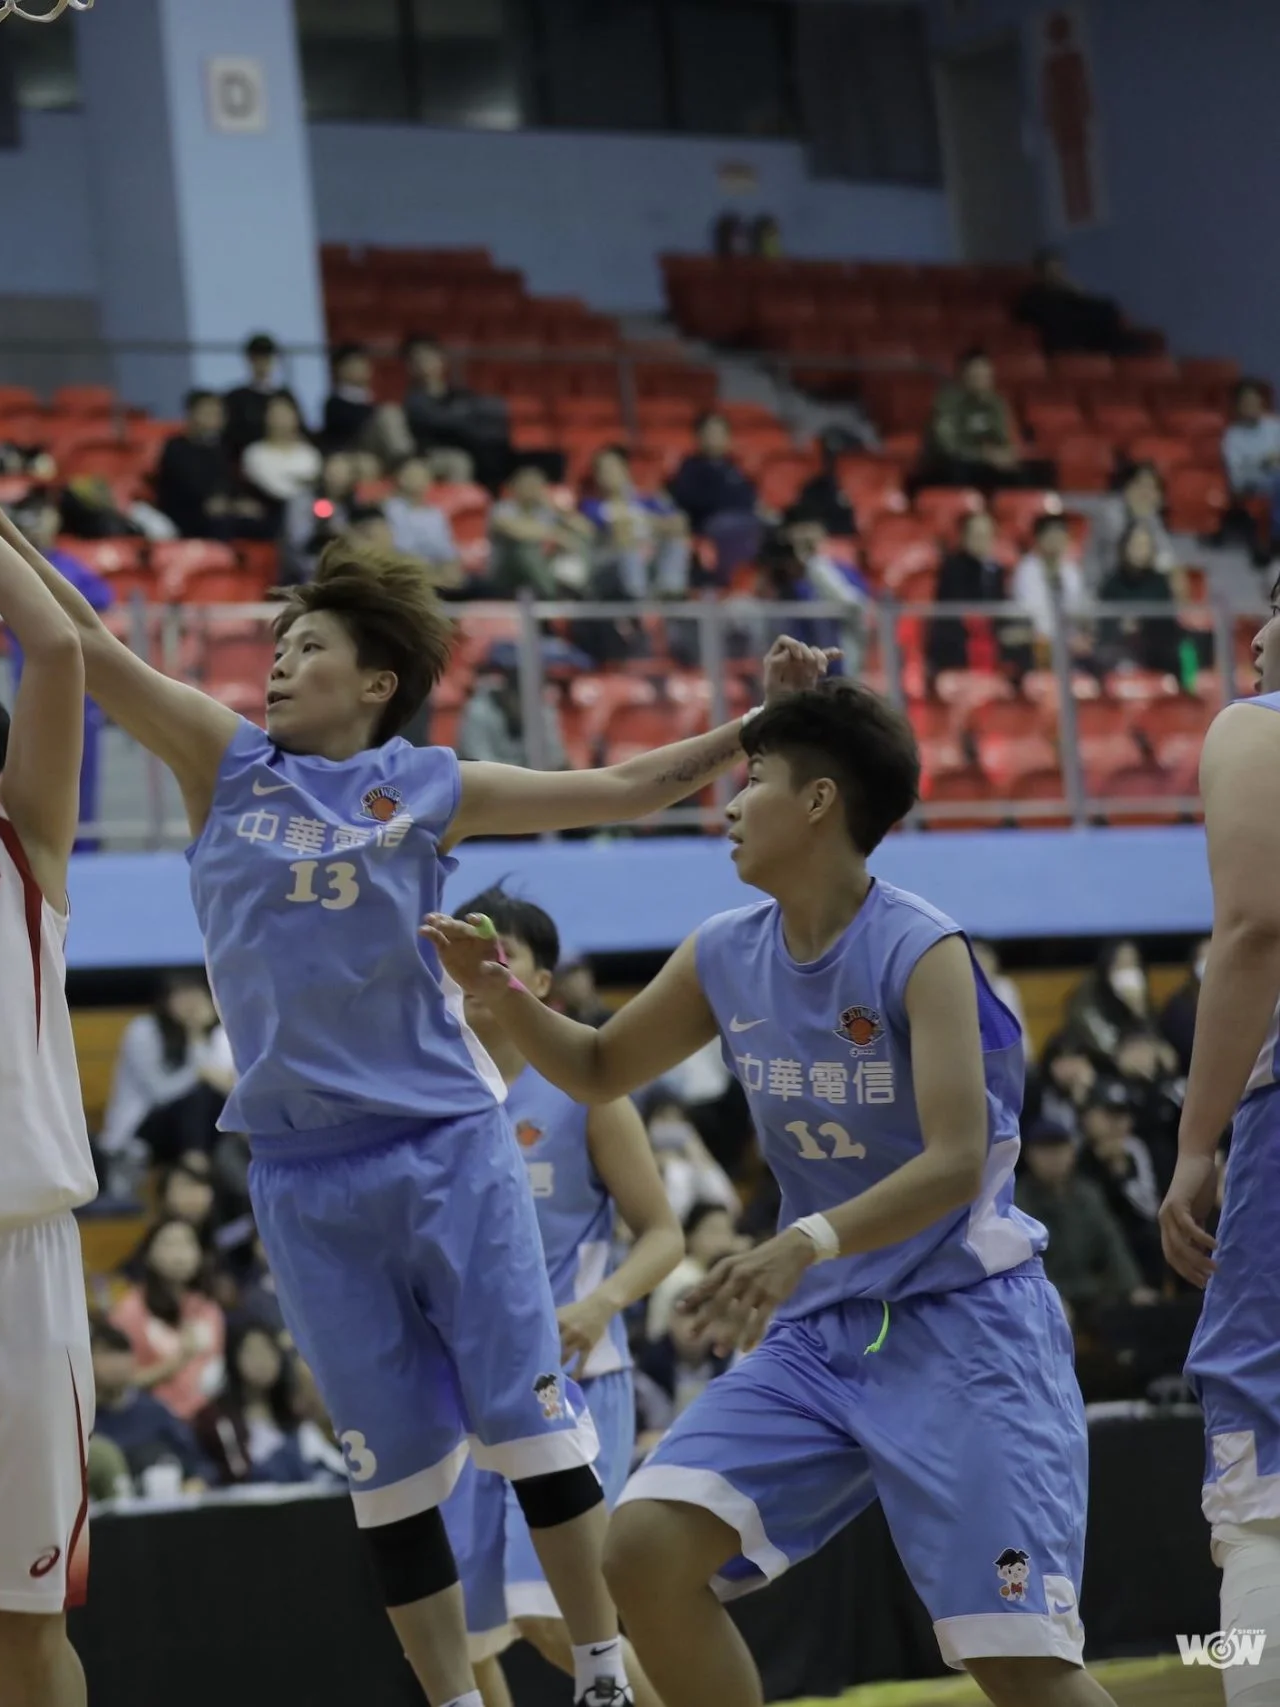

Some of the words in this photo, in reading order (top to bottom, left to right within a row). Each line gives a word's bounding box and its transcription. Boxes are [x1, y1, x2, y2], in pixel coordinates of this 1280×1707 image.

[285, 861, 360, 910] 13
[734, 1052, 896, 1104] 中華電信
[784, 1120, 866, 1160] 12
